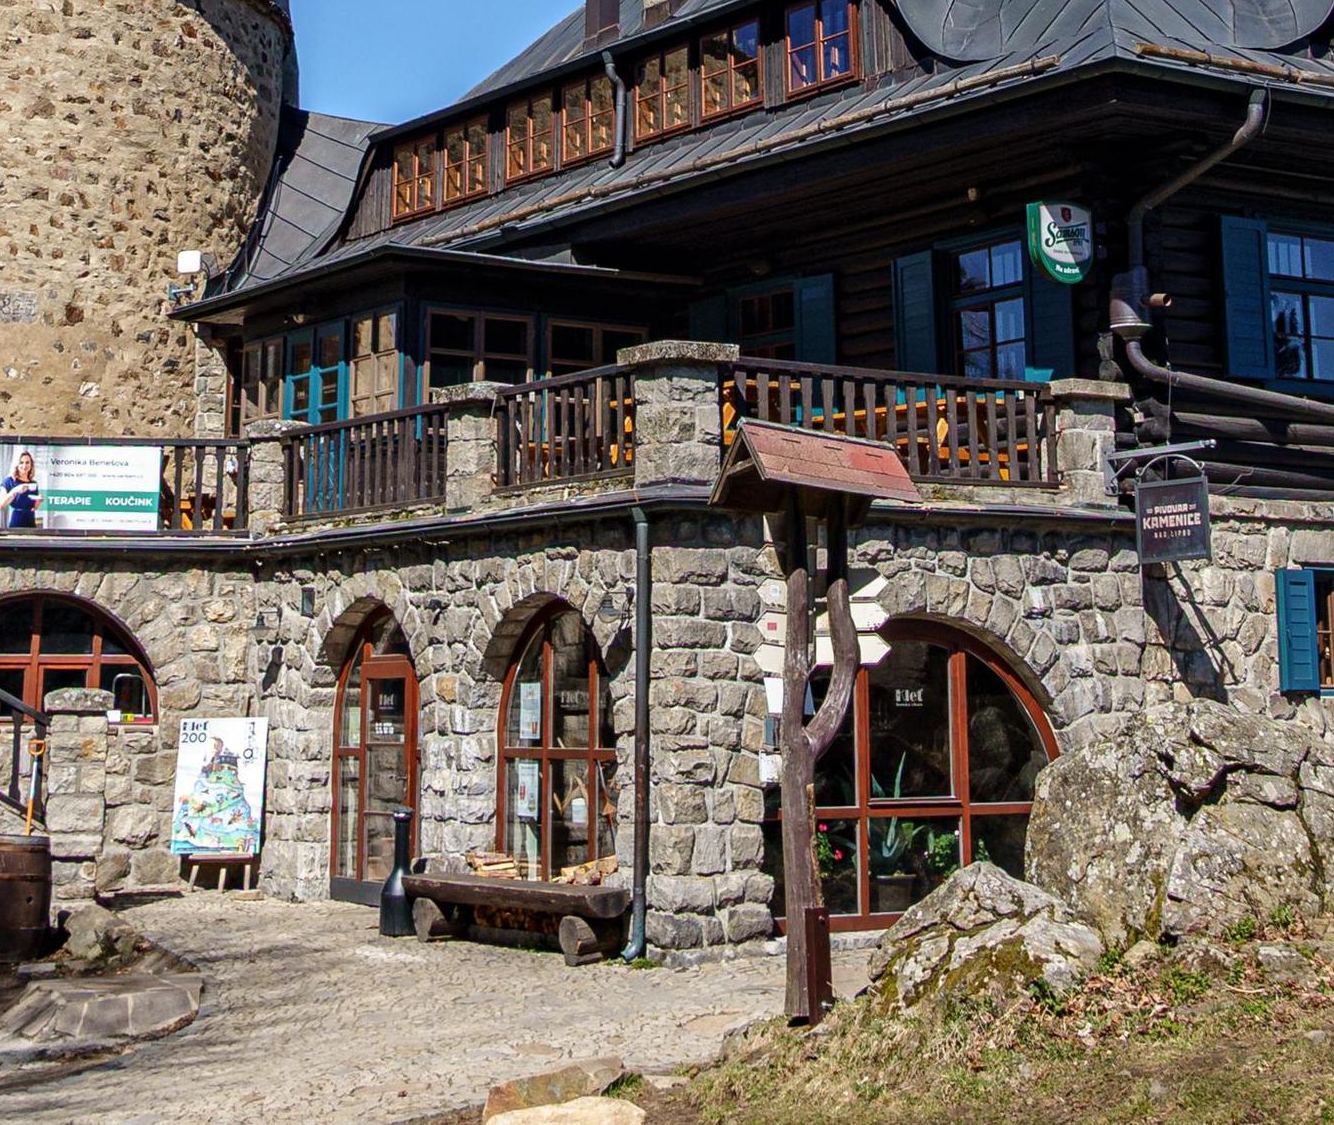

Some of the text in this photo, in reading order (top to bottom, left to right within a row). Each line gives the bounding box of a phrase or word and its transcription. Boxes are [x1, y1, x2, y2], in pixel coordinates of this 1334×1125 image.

[1045, 221, 1086, 247] Samson
[50, 458, 87, 466] Veronika
[48, 496, 92, 505] TERAPIE
[105, 496, 153, 506] KOUČINK
[1154, 503, 1188, 514] PIVOVAR
[1142, 512, 1202, 530] KAMENICE
[181, 732, 207, 744] 200
